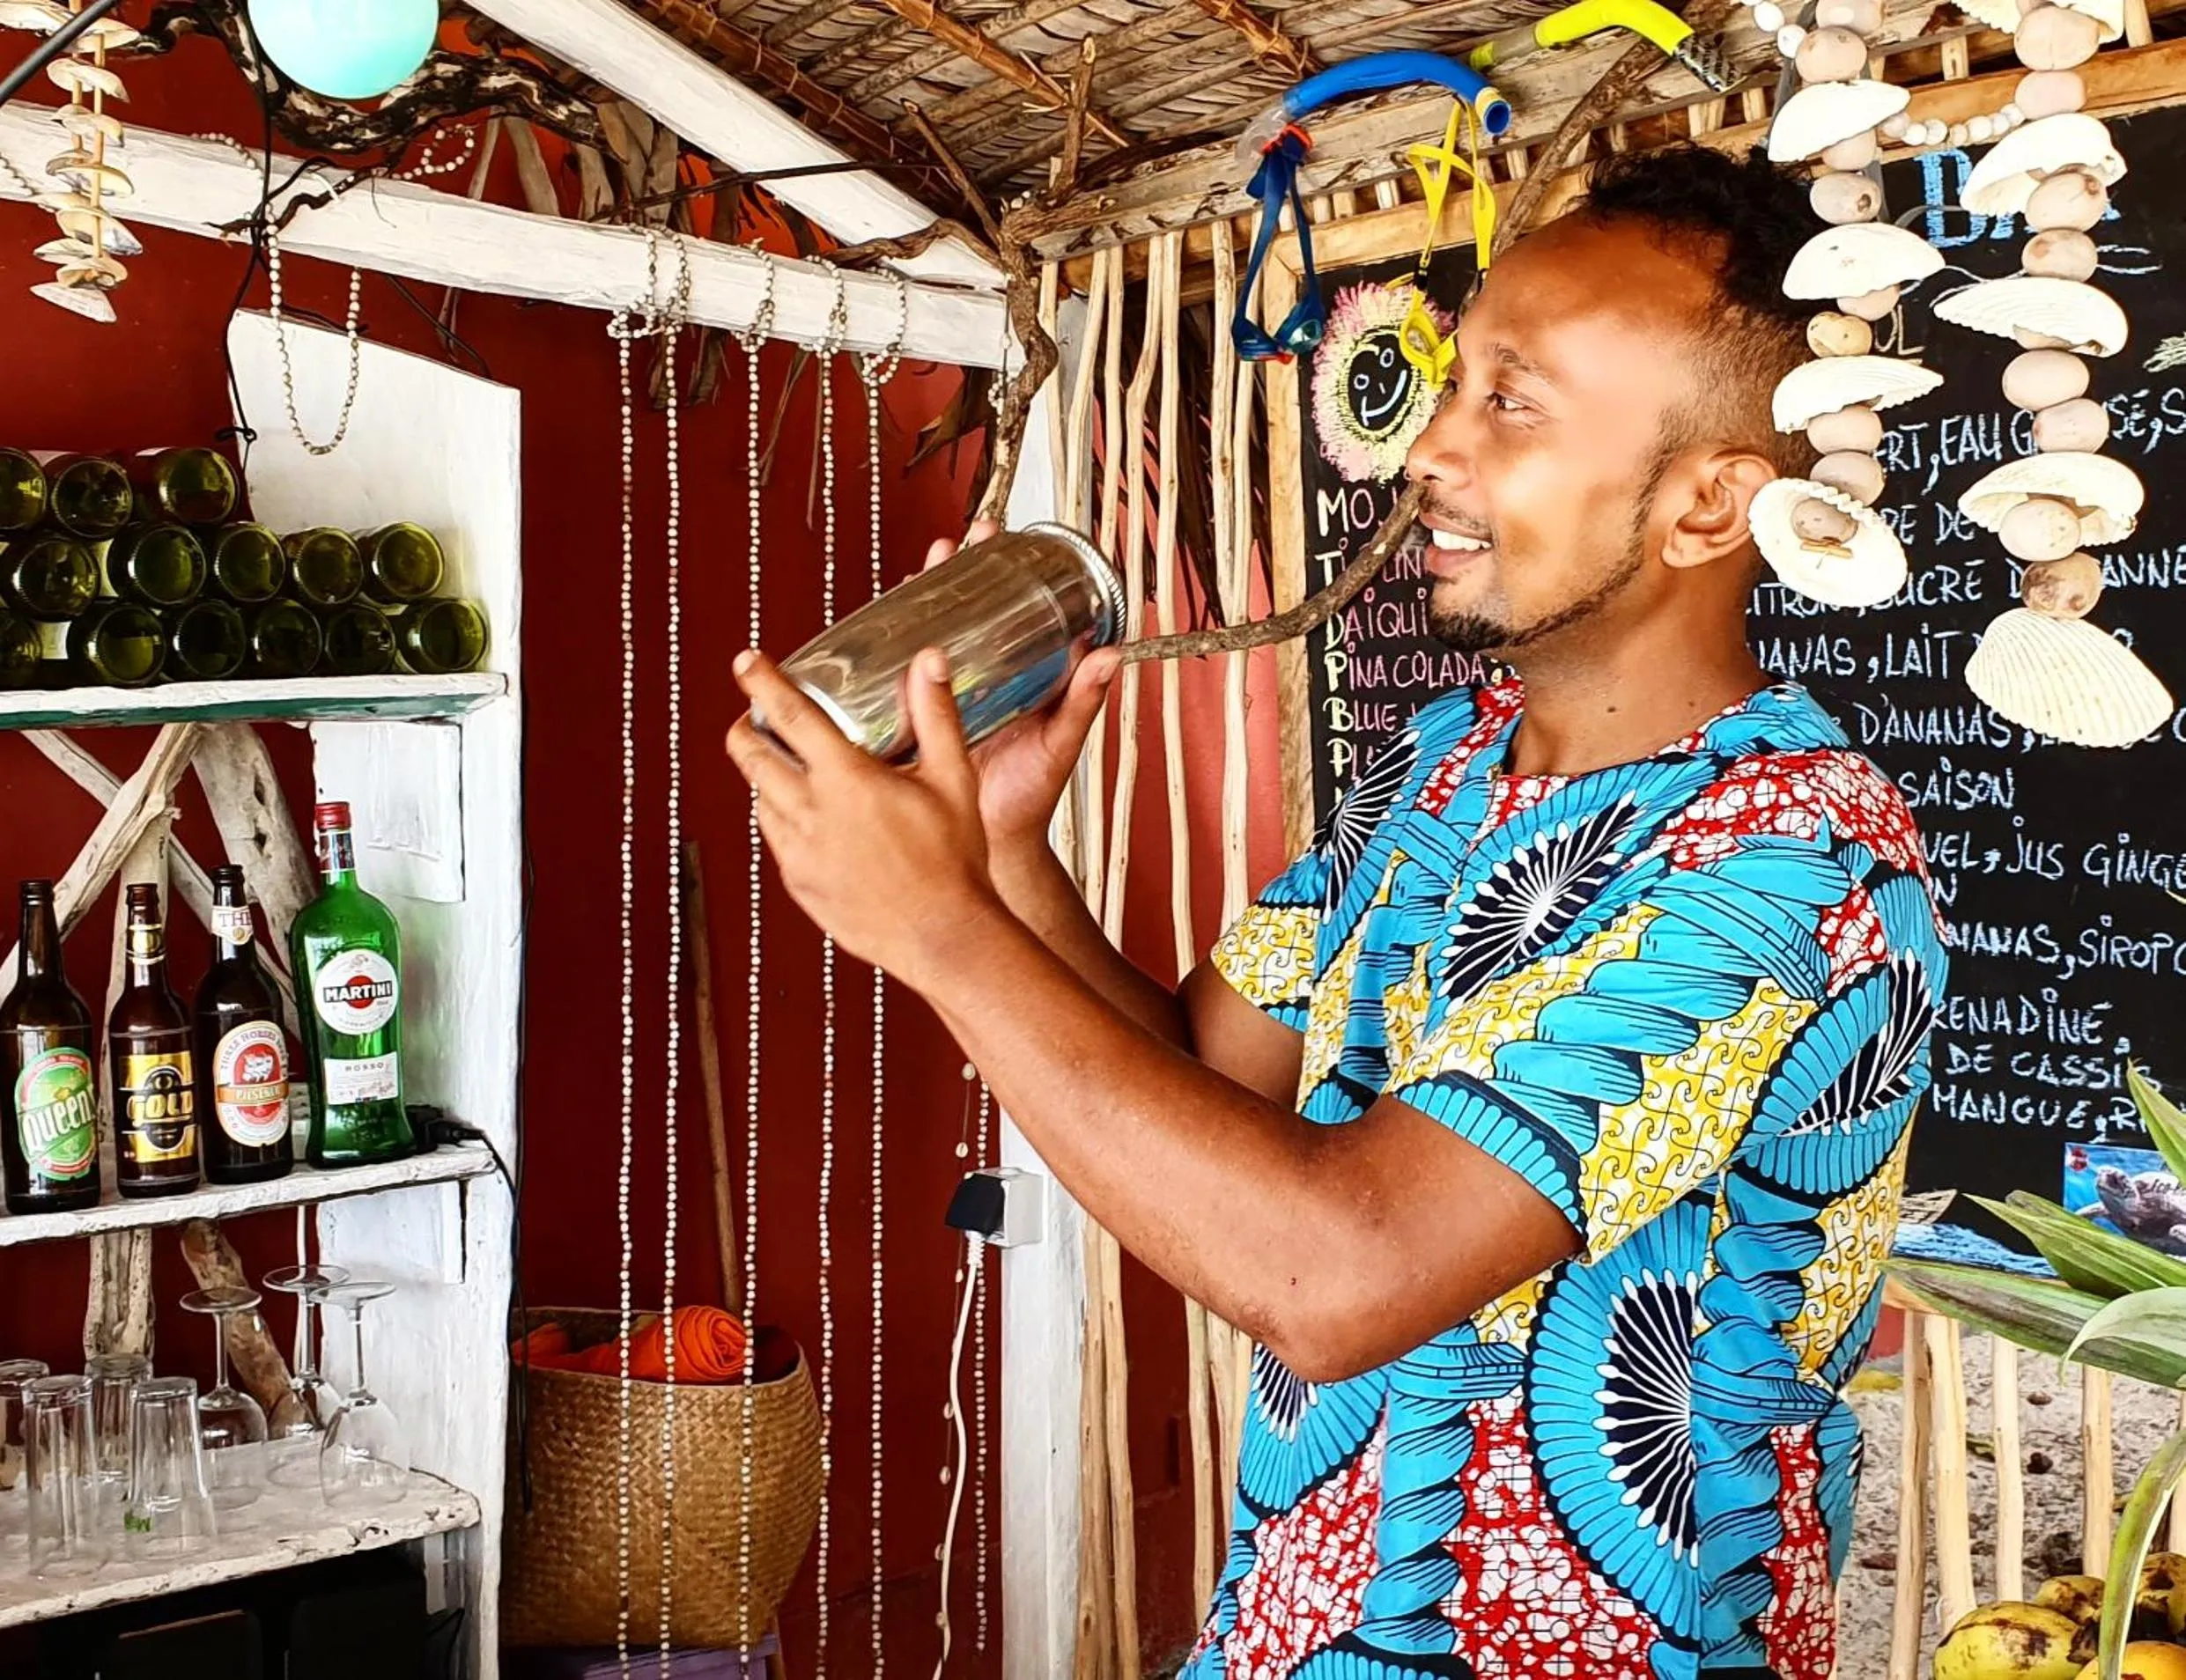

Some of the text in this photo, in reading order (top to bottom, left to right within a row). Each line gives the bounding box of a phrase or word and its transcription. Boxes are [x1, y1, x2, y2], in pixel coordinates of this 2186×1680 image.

[2101, 545, 2186, 588] ANNE
[1392, 651, 1488, 689] COLADA
[1323, 696, 1399, 732] BLUE
[325, 981, 393, 1002] MARTINI
[127, 1090, 193, 1128] GOLD
